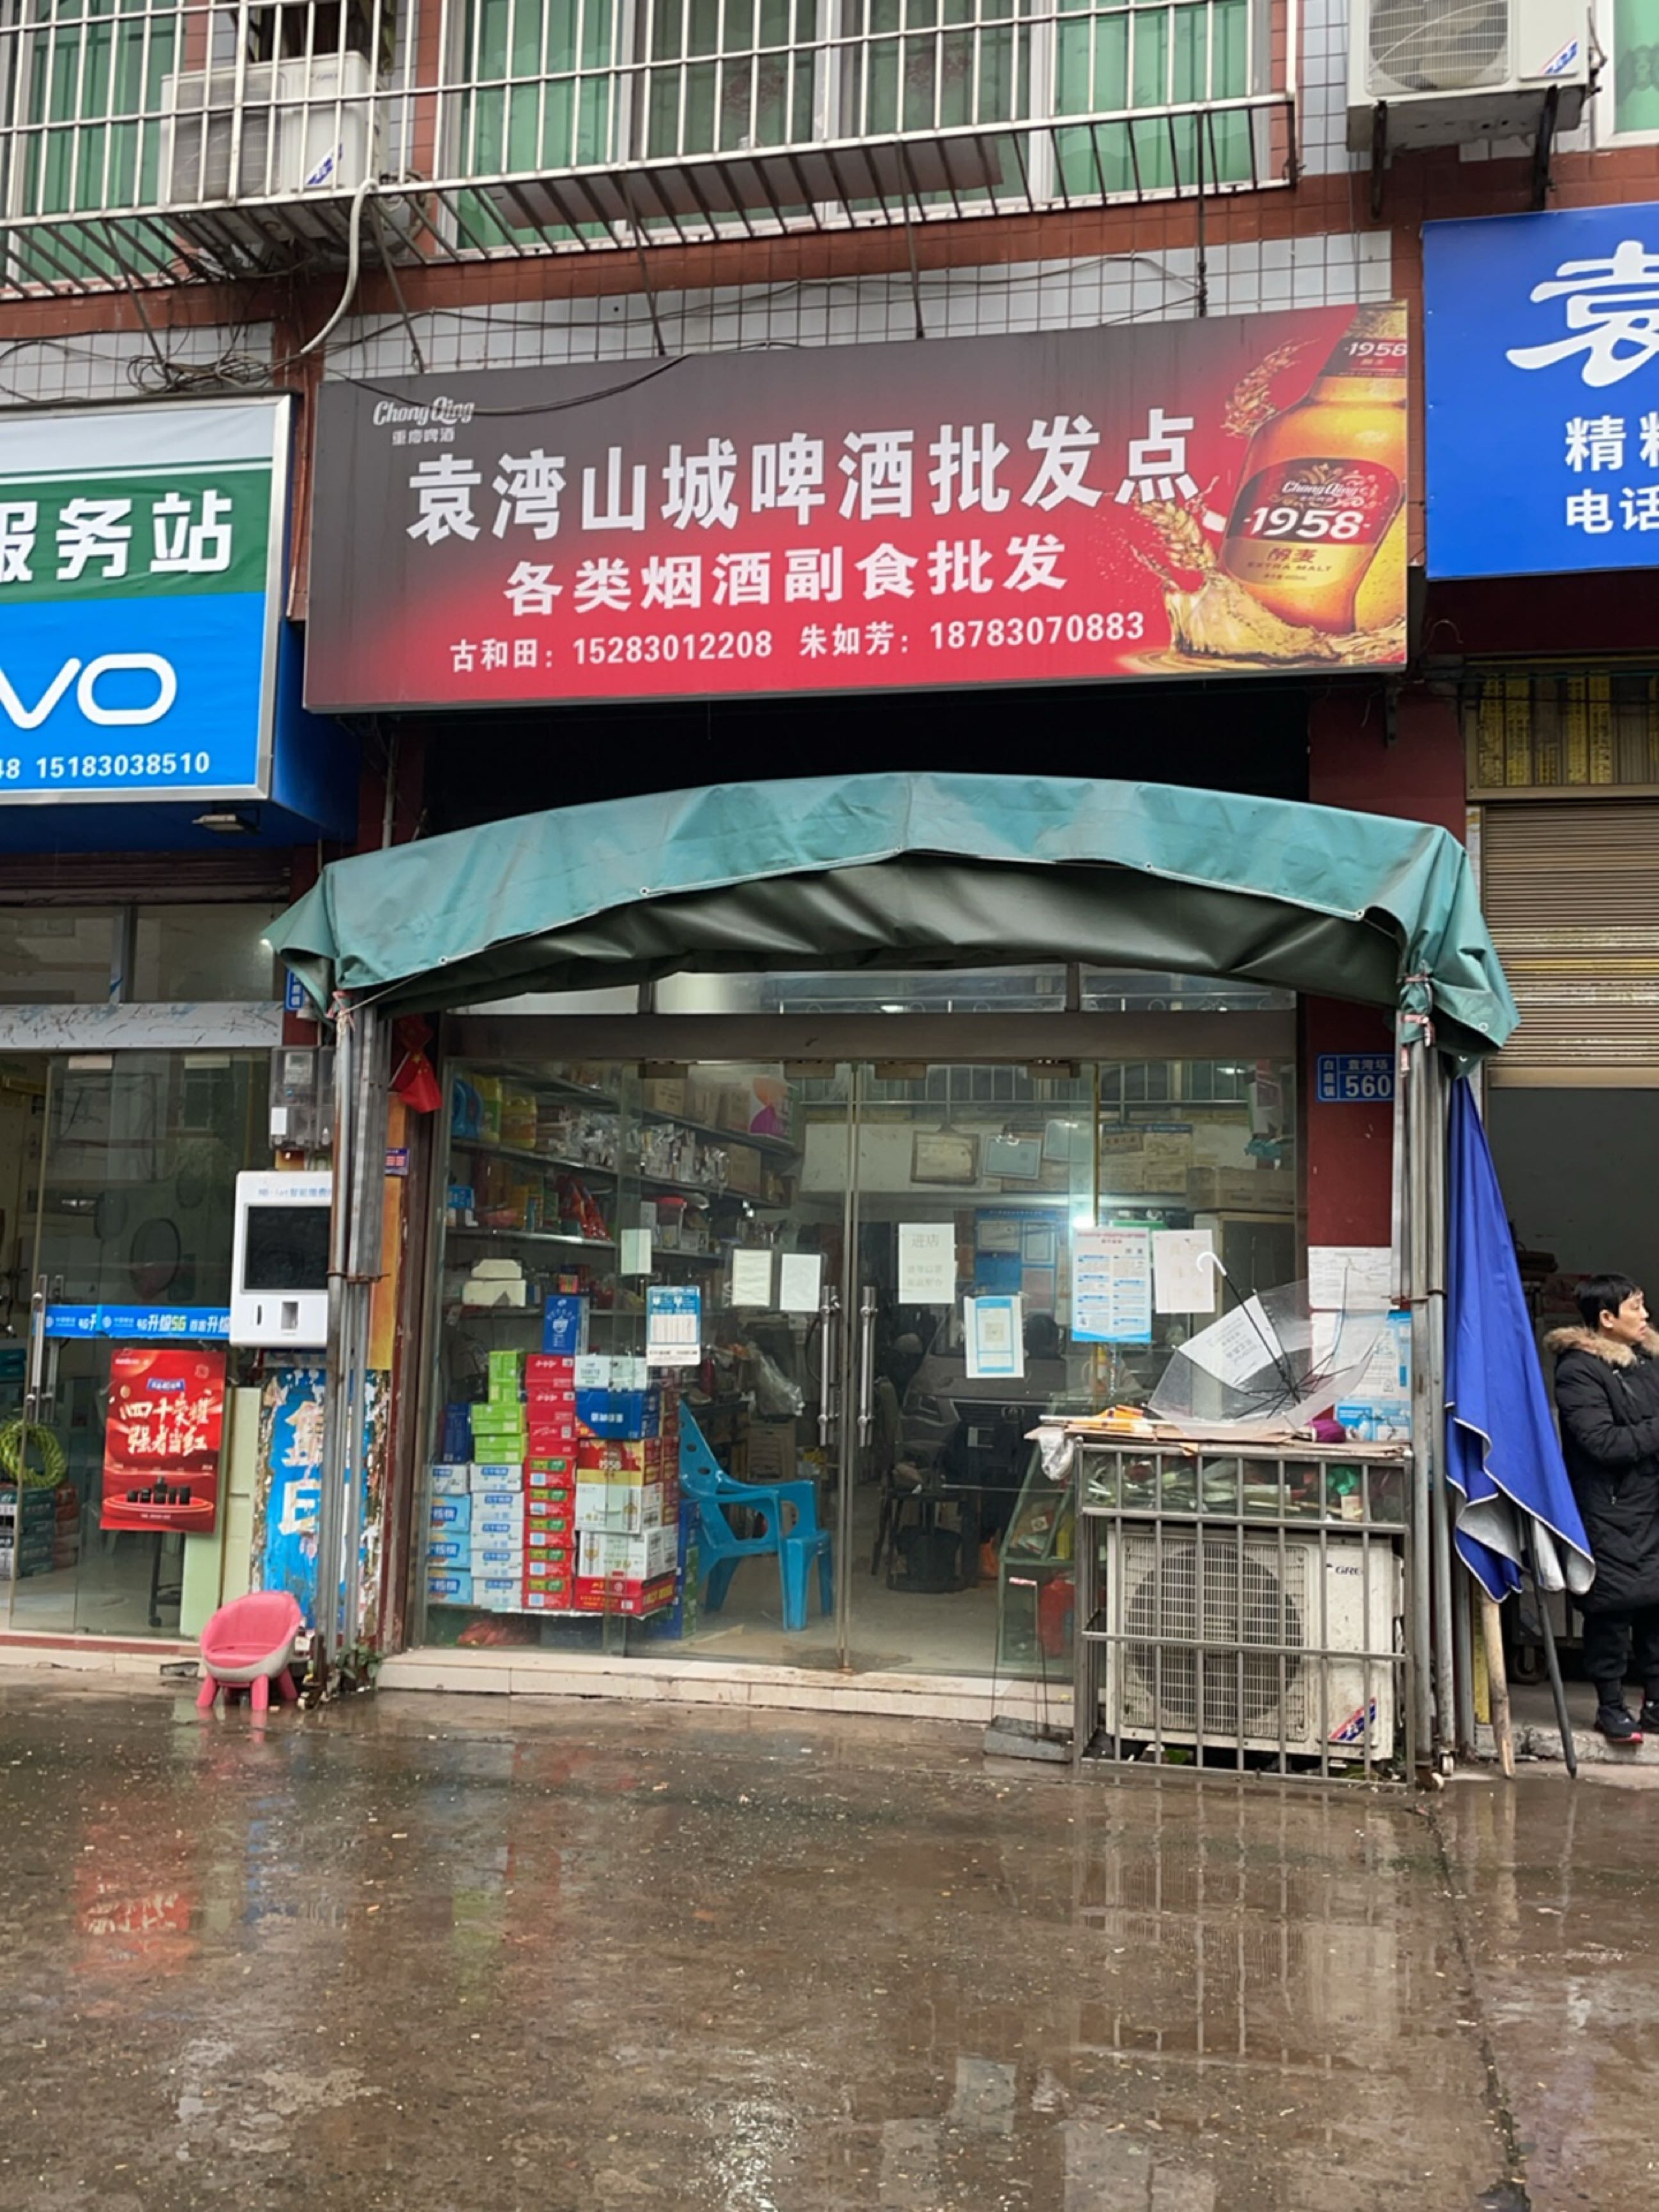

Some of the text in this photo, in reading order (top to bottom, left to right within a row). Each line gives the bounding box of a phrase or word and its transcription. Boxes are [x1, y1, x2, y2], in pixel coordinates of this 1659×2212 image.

[406, 408, 1199, 546] 袁湾山城啤酒批发点
[1566, 485, 1659, 534] 电话
[504, 533, 1068, 616] 各类烟酒副食批发
[574, 630, 772, 665] 15283012208
[930, 611, 1144, 650] 18783070883
[36, 751, 210, 778] 15183038510
[1345, 1074, 1391, 1098] 560
